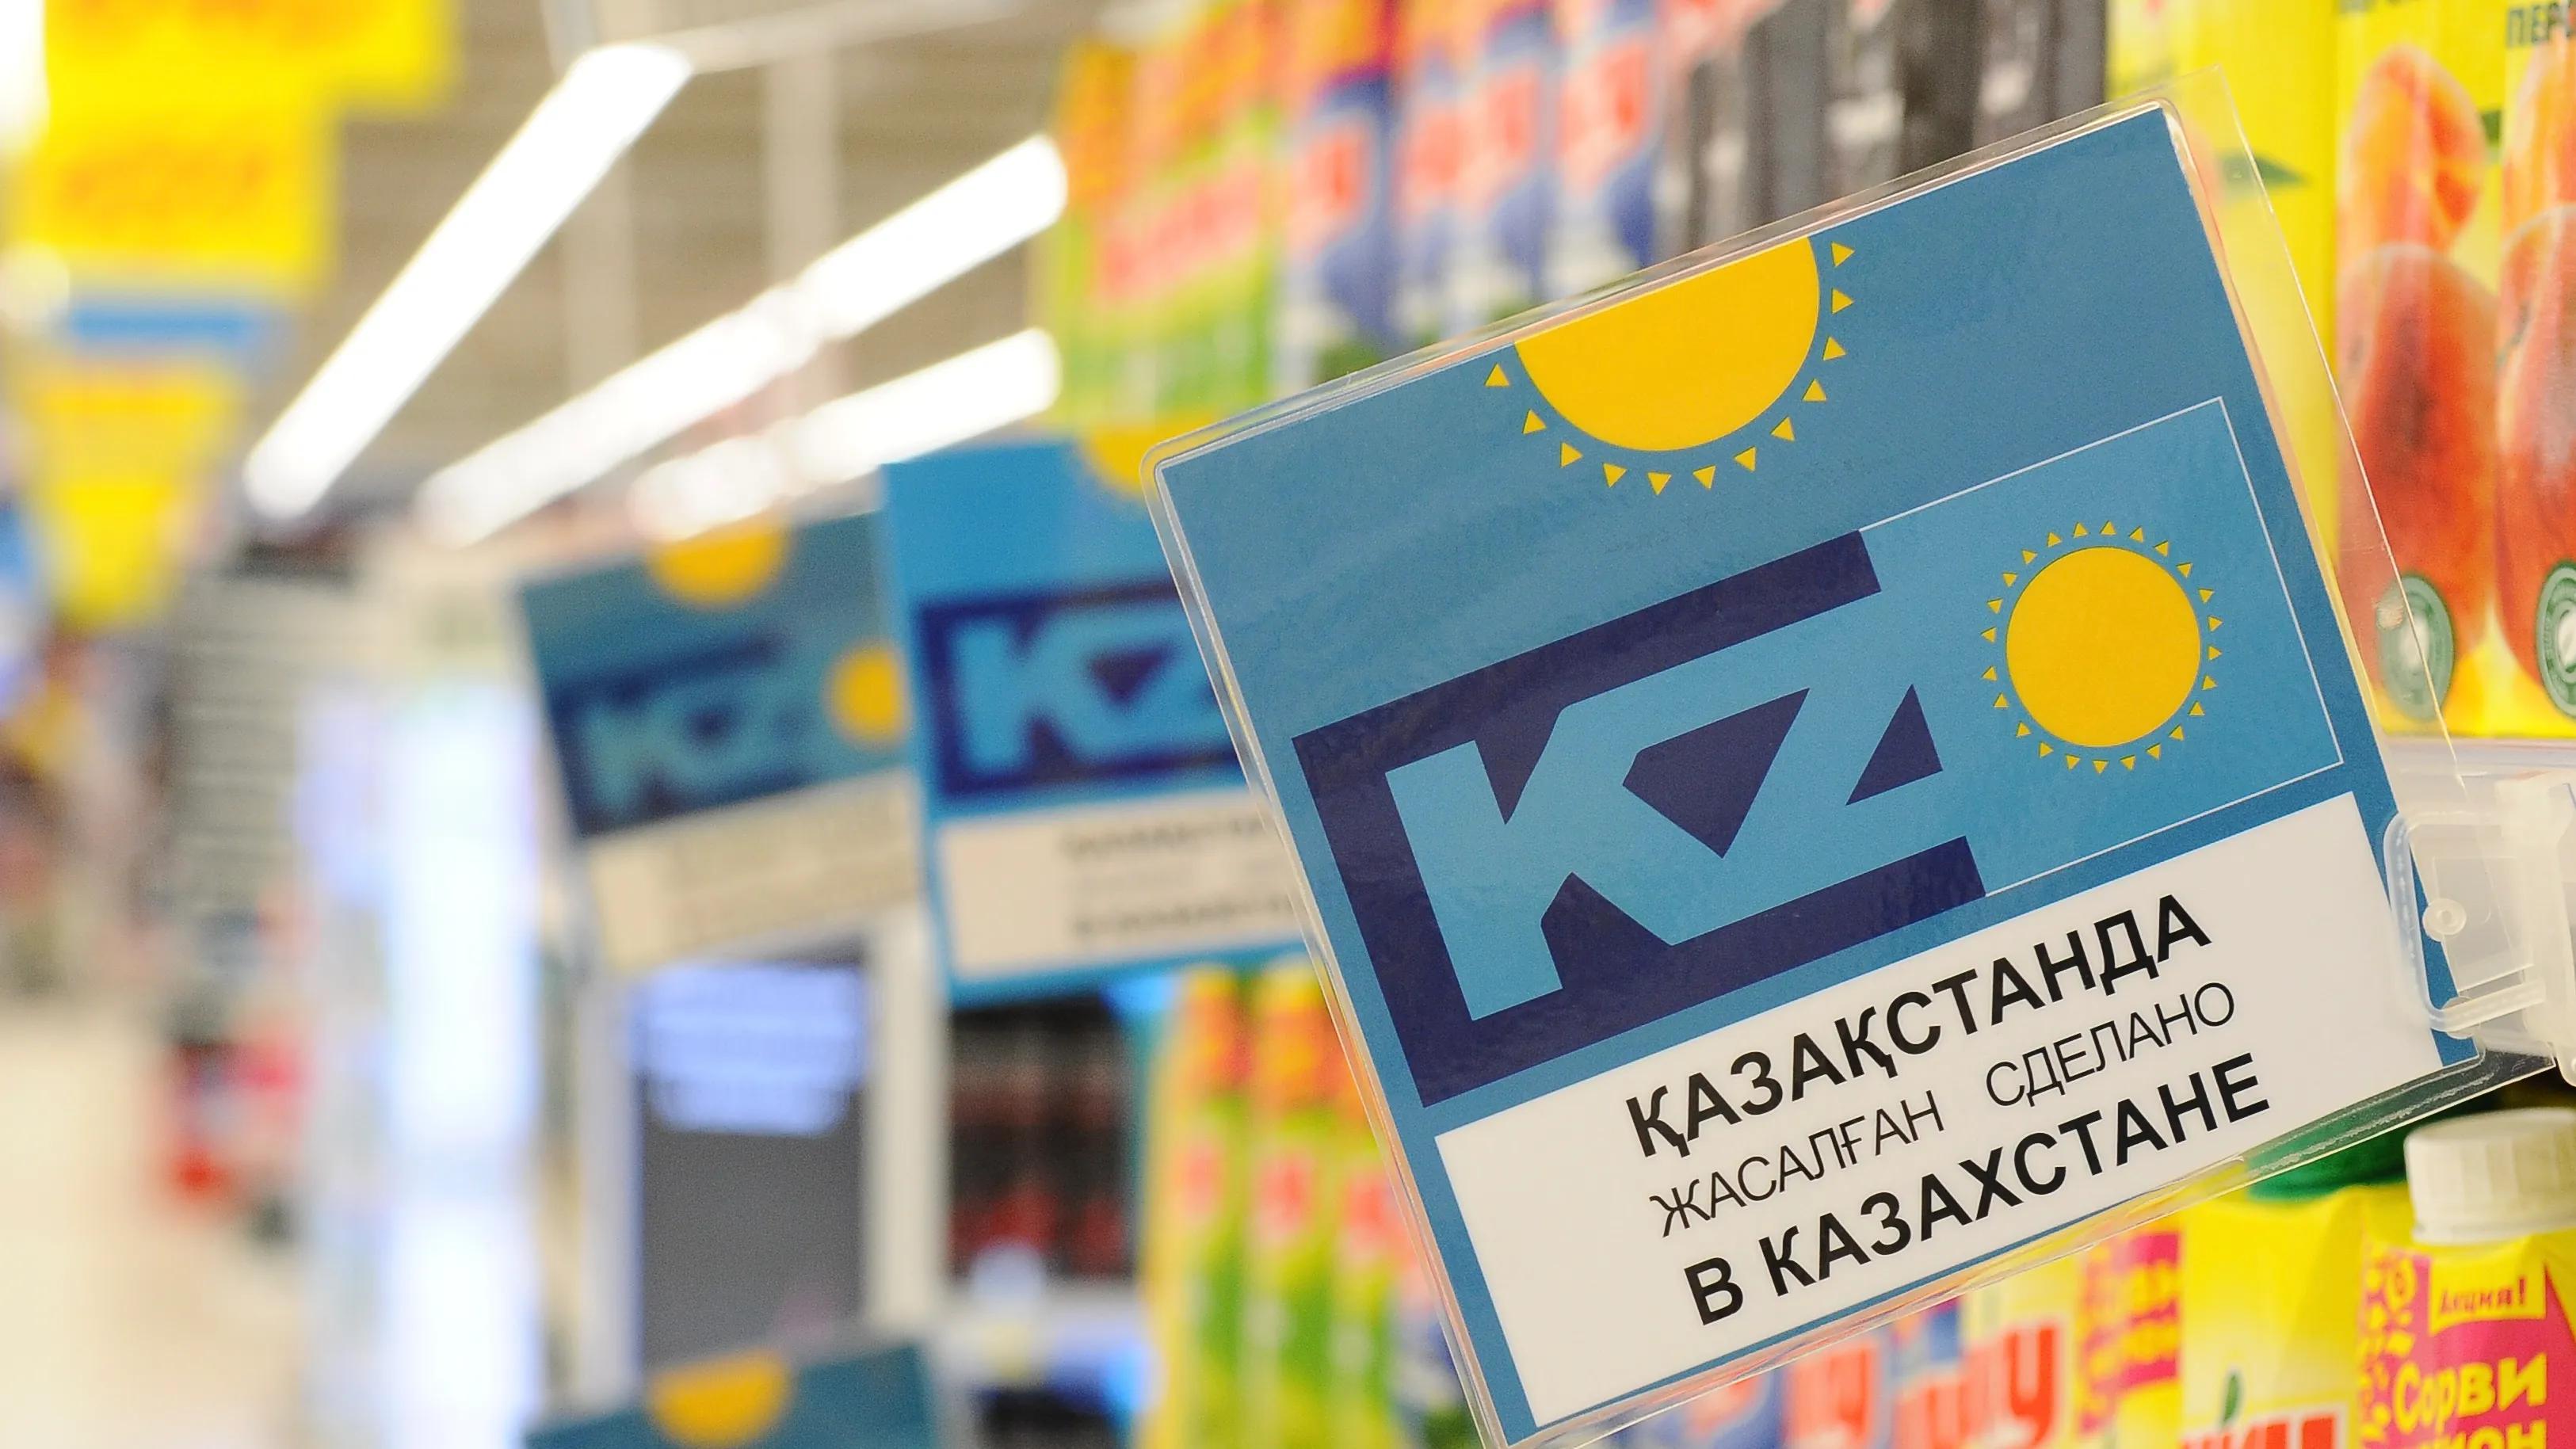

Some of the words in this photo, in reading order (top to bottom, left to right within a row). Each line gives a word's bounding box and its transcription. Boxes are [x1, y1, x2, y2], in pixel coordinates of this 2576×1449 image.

[1386, 590, 1957, 1020] KZ
[1626, 894, 2212, 1158] ҚАЗАҚСТАНДА
[1649, 1090, 1944, 1237] ЖАСАЛҒАН
[1986, 982, 2235, 1108] СДЕЛАНО
[1685, 1257, 1744, 1325] В
[1758, 1053, 2270, 1297] КАЗАХСТАНЕ
